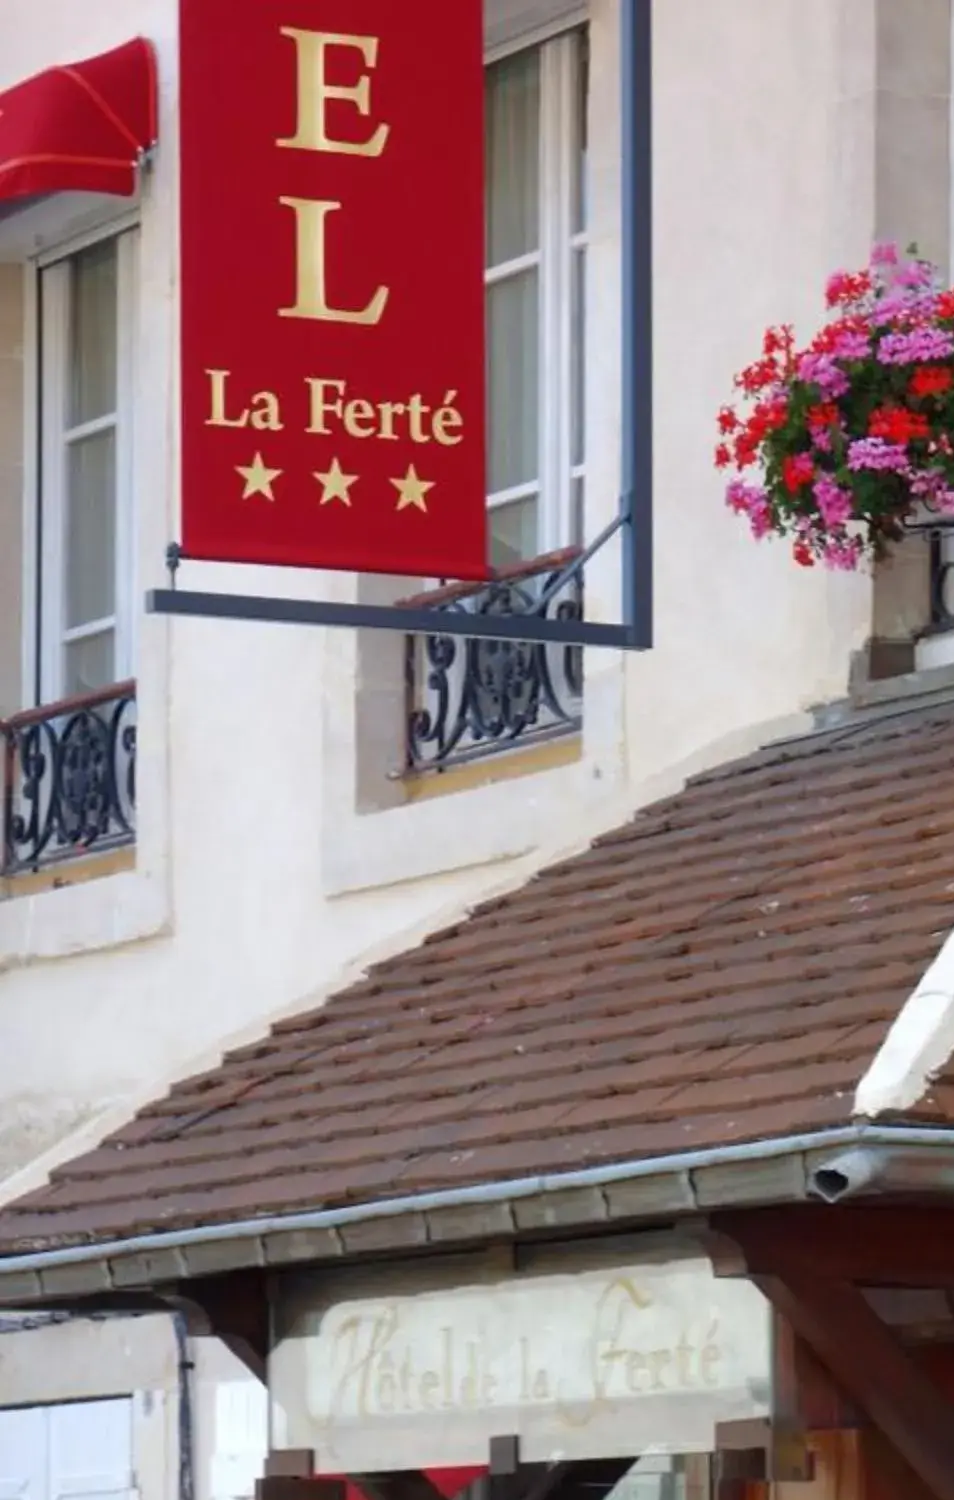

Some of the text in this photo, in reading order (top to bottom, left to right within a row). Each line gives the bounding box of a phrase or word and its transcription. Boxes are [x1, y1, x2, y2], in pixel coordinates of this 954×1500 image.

[204, 368, 465, 446] La Ferté
[519, 1336, 550, 1400] la
